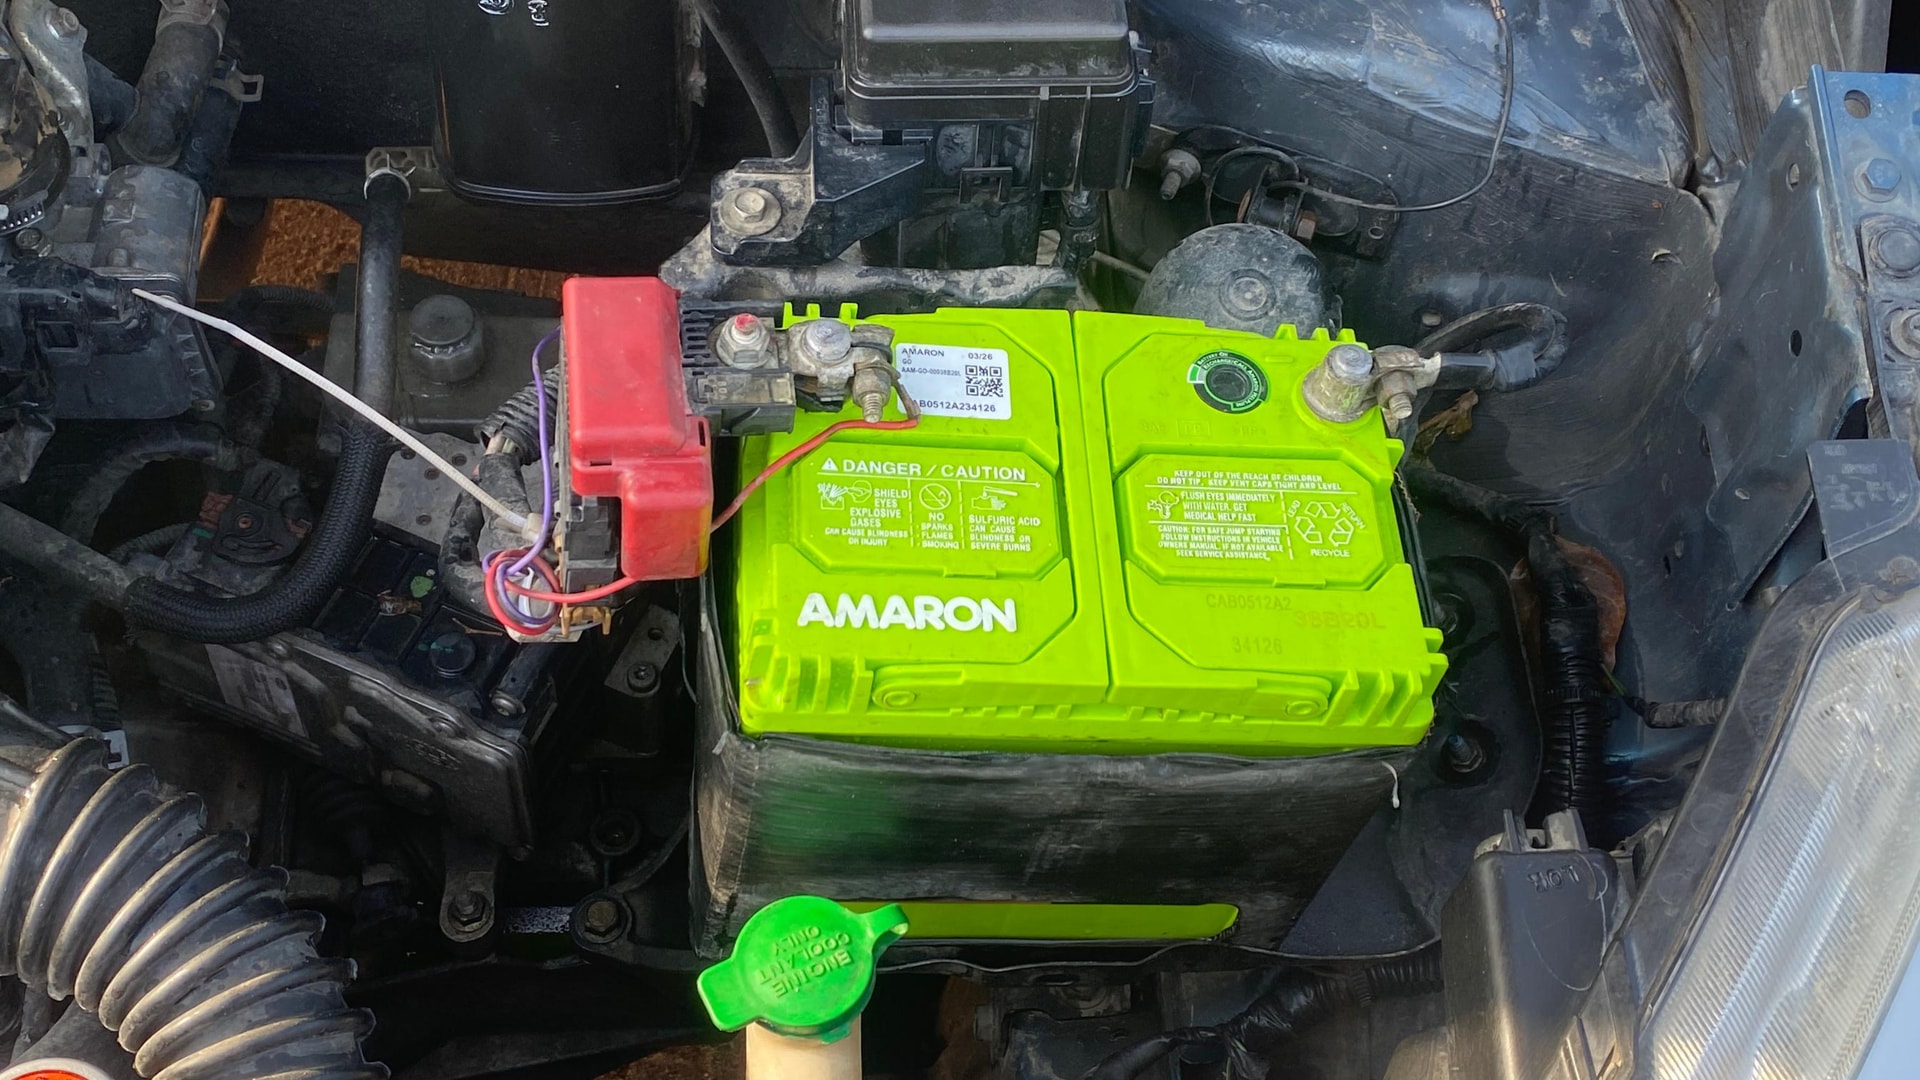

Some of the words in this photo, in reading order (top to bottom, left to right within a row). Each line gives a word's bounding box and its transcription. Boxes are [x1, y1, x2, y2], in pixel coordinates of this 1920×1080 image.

[901, 348, 945, 357] AMARON
[968, 353, 993, 361] 03/26
[914, 400, 996, 412] B0512A234126
[843, 459, 921, 476] DANGER
[941, 464, 1026, 481] CAUTION
[1175, 470, 1194, 478] KEEP
[1196, 471, 1211, 479] OUT
[1213, 471, 1224, 479] OF
[1226, 472, 1241, 480] THE
[1243, 472, 1269, 481] REACH
[1271, 473, 1282, 481] OF
[1283, 474, 1322, 482] CHILDREN
[1157, 476, 1168, 484] DO
[1170, 477, 1186, 485] NOT
[1208, 479, 1228, 487] KEEP
[1319, 483, 1342, 491] LEVEL
[874, 488, 909, 499] SHIELD
[1181, 491, 1205, 500] FLUSH
[1206, 492, 1225, 501] EYES
[1227, 493, 1275, 503] IMMEDIATELY
[875, 498, 898, 508] EYES
[1182, 501, 1203, 510] WITH
[1233, 503, 1247, 512] GET
[850, 507, 902, 518] EXPLOSIVE
[929, 512, 944, 521] NO
[1184, 511, 1216, 521] MEDICAL
[1218, 512, 1237, 521] HELP
[1238, 513, 1256, 522] FAST
[1342, 501, 1366, 529] RETURN
[850, 518, 881, 527] GASES
[969, 514, 1015, 525] SULFURIC
[1018, 517, 1040, 526] ACID
[921, 522, 953, 531] SPARKS
[969, 525, 986, 533] CAN
[990, 525, 1016, 534] CAUSE
[1192, 526, 1206, 534] FOR
[1207, 527, 1225, 535] SAFE
[1226, 527, 1245, 535] JUMP
[1247, 528, 1281, 537] STARTING
[825, 527, 841, 536] CAN
[841, 528, 865, 537] CAUSE
[867, 529, 908, 538] BLINDNESS
[922, 531, 953, 540] FLAMES
[970, 533, 1015, 543] BLINDNESS
[1019, 535, 1031, 543] OR
[848, 537, 859, 545] OR
[861, 538, 888, 547] INJURY
[1161, 533, 1190, 541] FOLLOW
[1191, 534, 1239, 543] INSTRUCTIONS
[1252, 536, 1281, 544] VEHICLE
[922, 540, 959, 549] SMOKING
[971, 542, 1001, 551] SEVERE
[1003, 543, 1031, 552] BURNS
[1231, 543, 1246, 551] NOT
[1247, 544, 1283, 553] AVAILABLE
[1176, 549, 1194, 557] SEEK
[1195, 550, 1223, 559] SERVICE
[1311, 548, 1351, 558] RECYCLE
[1206, 593, 1292, 611] CAB0512A2
[797, 592, 1017, 633] AMARON
[1232, 635, 1283, 655] 34126
[772, 926, 821, 957] ONLY
[760, 933, 852, 985] COOLANT
[772, 950, 855, 998] ENGINE
